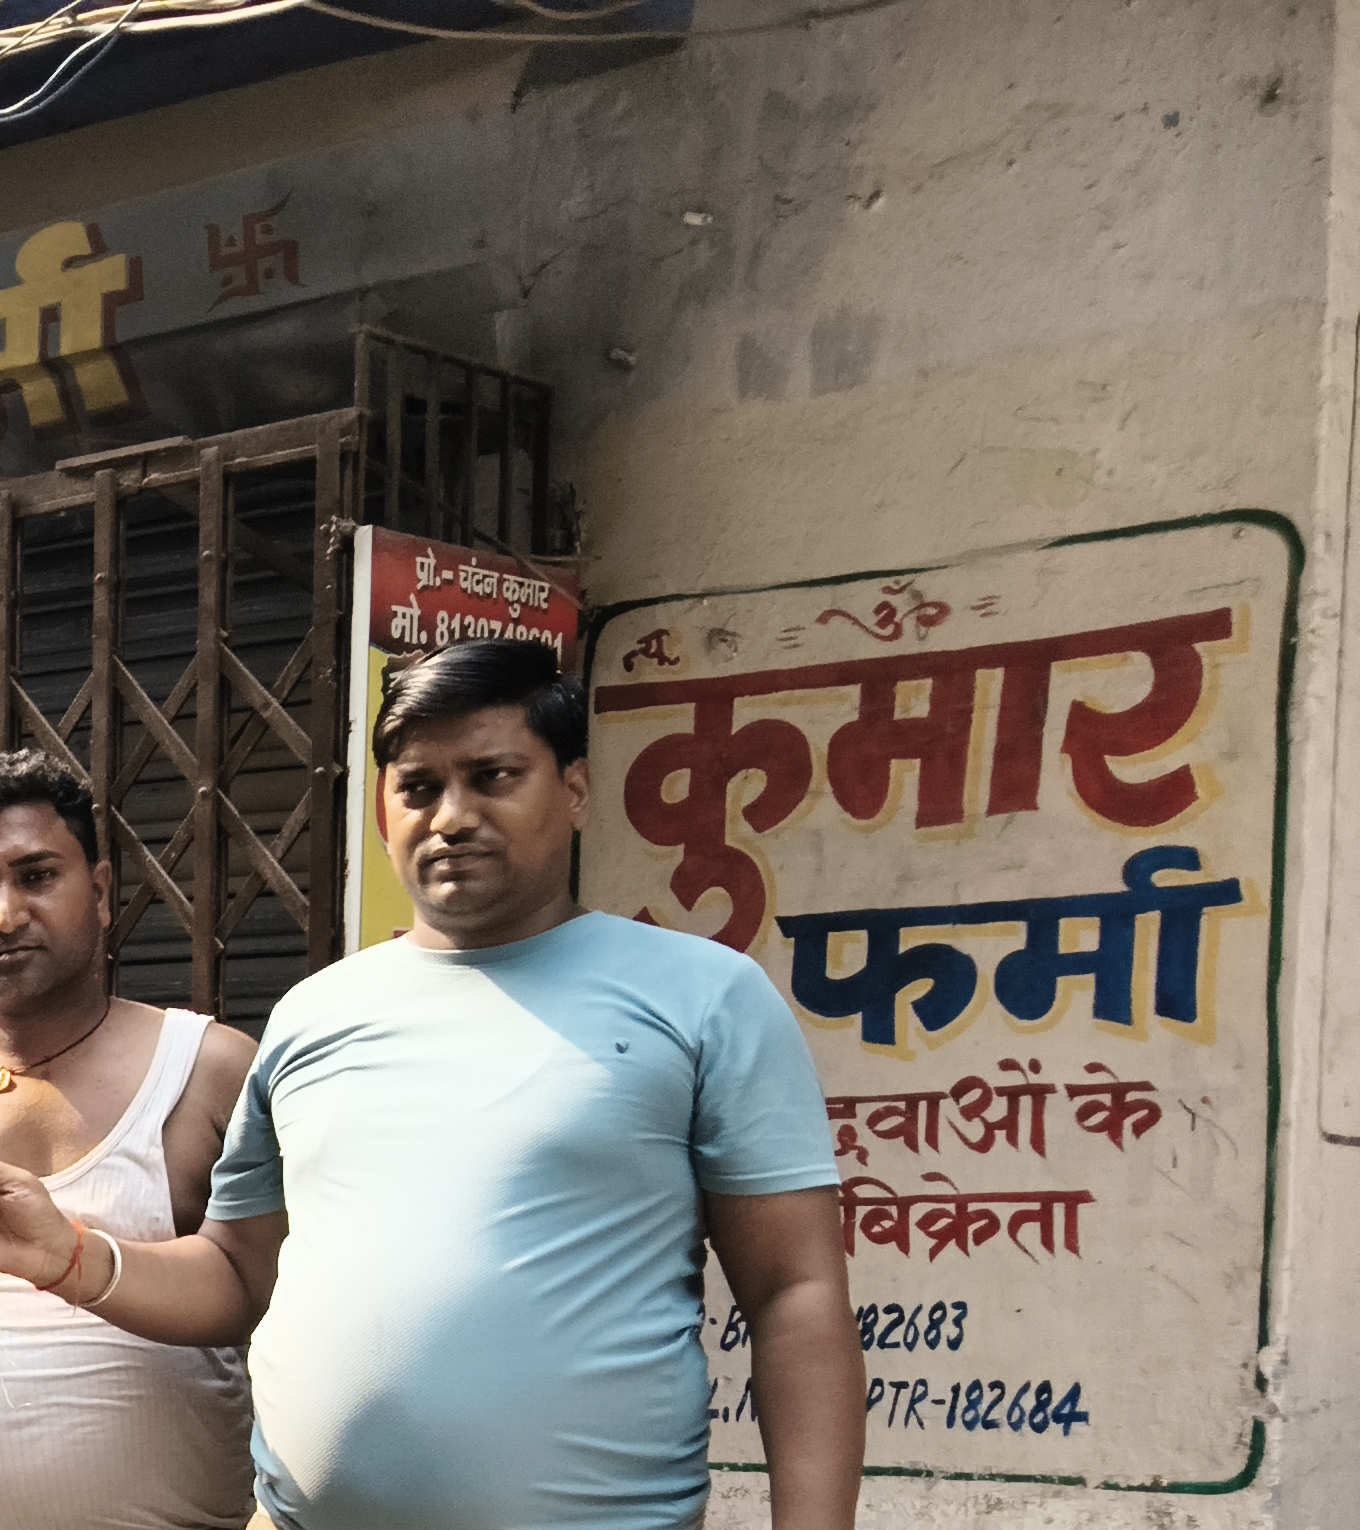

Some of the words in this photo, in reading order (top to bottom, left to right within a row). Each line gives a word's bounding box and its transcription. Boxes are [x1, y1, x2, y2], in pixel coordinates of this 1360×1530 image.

[459, 557, 500, 599] चंदन
[503, 573, 550, 618] कुमार
[594, 606, 1233, 955] कुमार
[775, 845, 1243, 1046] फर्मा
[1066, 1062, 1163, 1150] के
